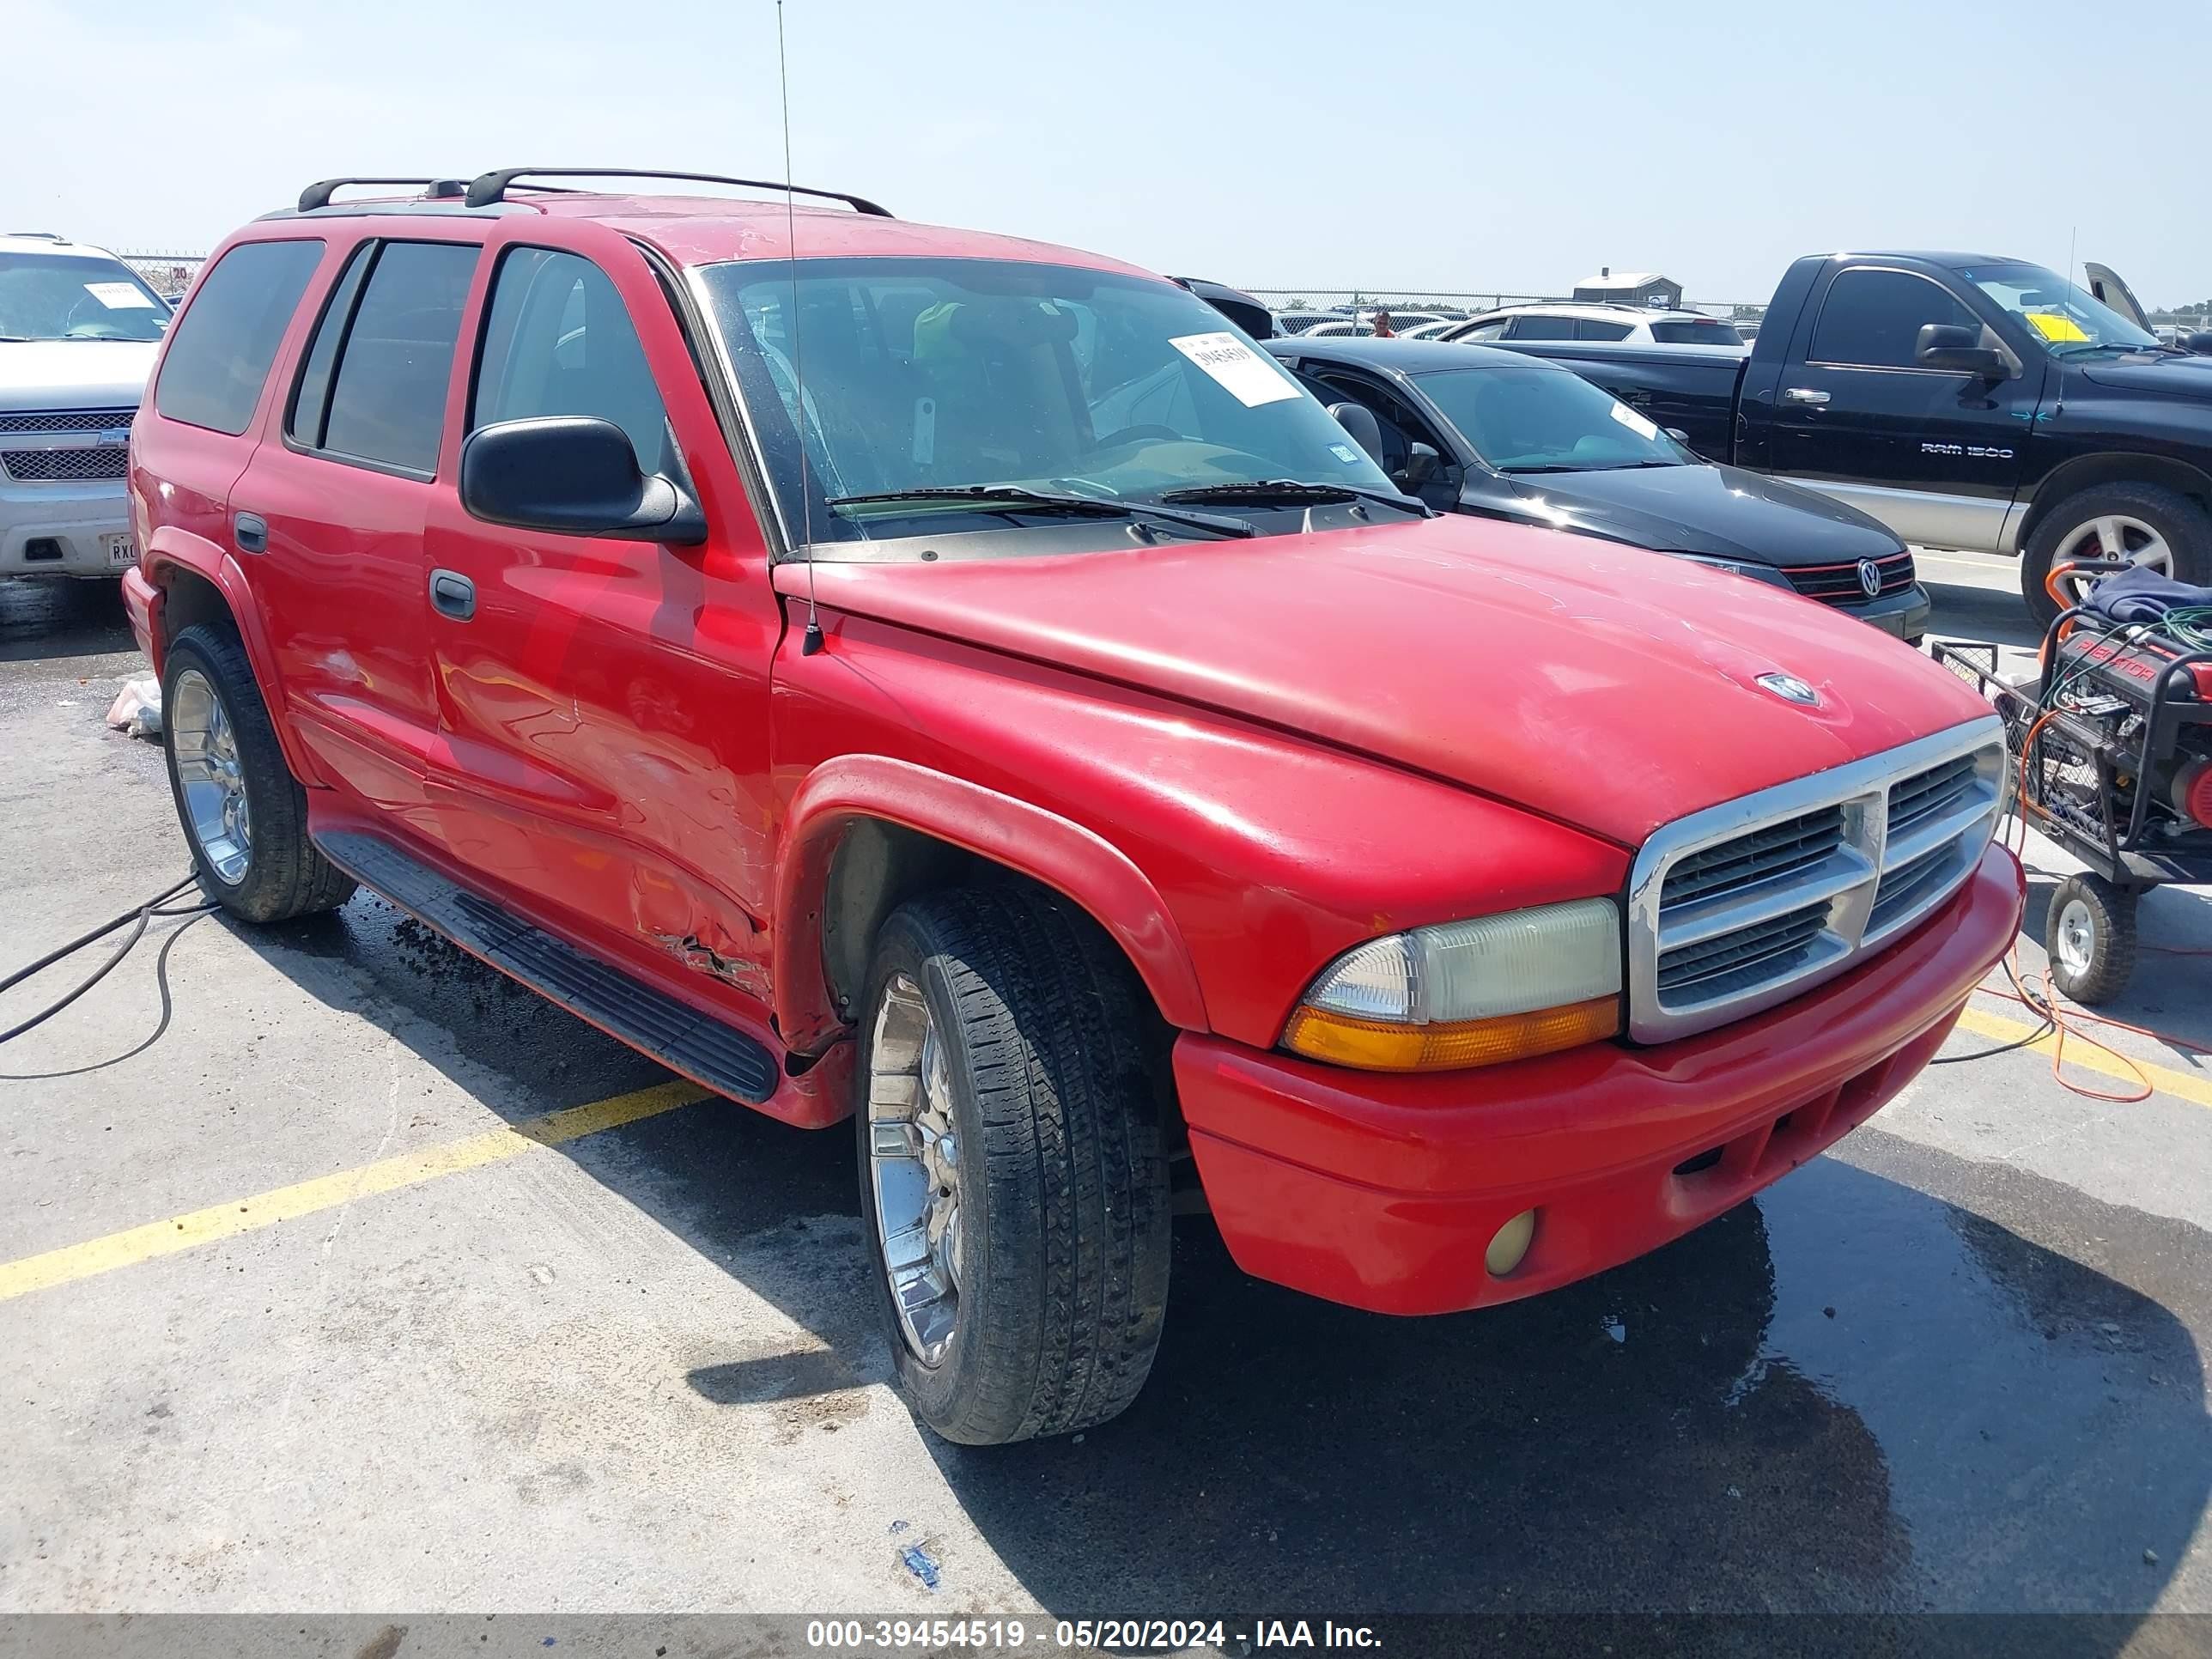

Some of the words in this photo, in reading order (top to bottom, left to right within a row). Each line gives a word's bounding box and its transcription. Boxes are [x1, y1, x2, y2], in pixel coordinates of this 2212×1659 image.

[173, 268, 187, 280] 20
[1921, 443, 1962, 455] RAM
[1967, 446, 2014, 459] 1500
[2075, 641, 2157, 682] PEATOR
